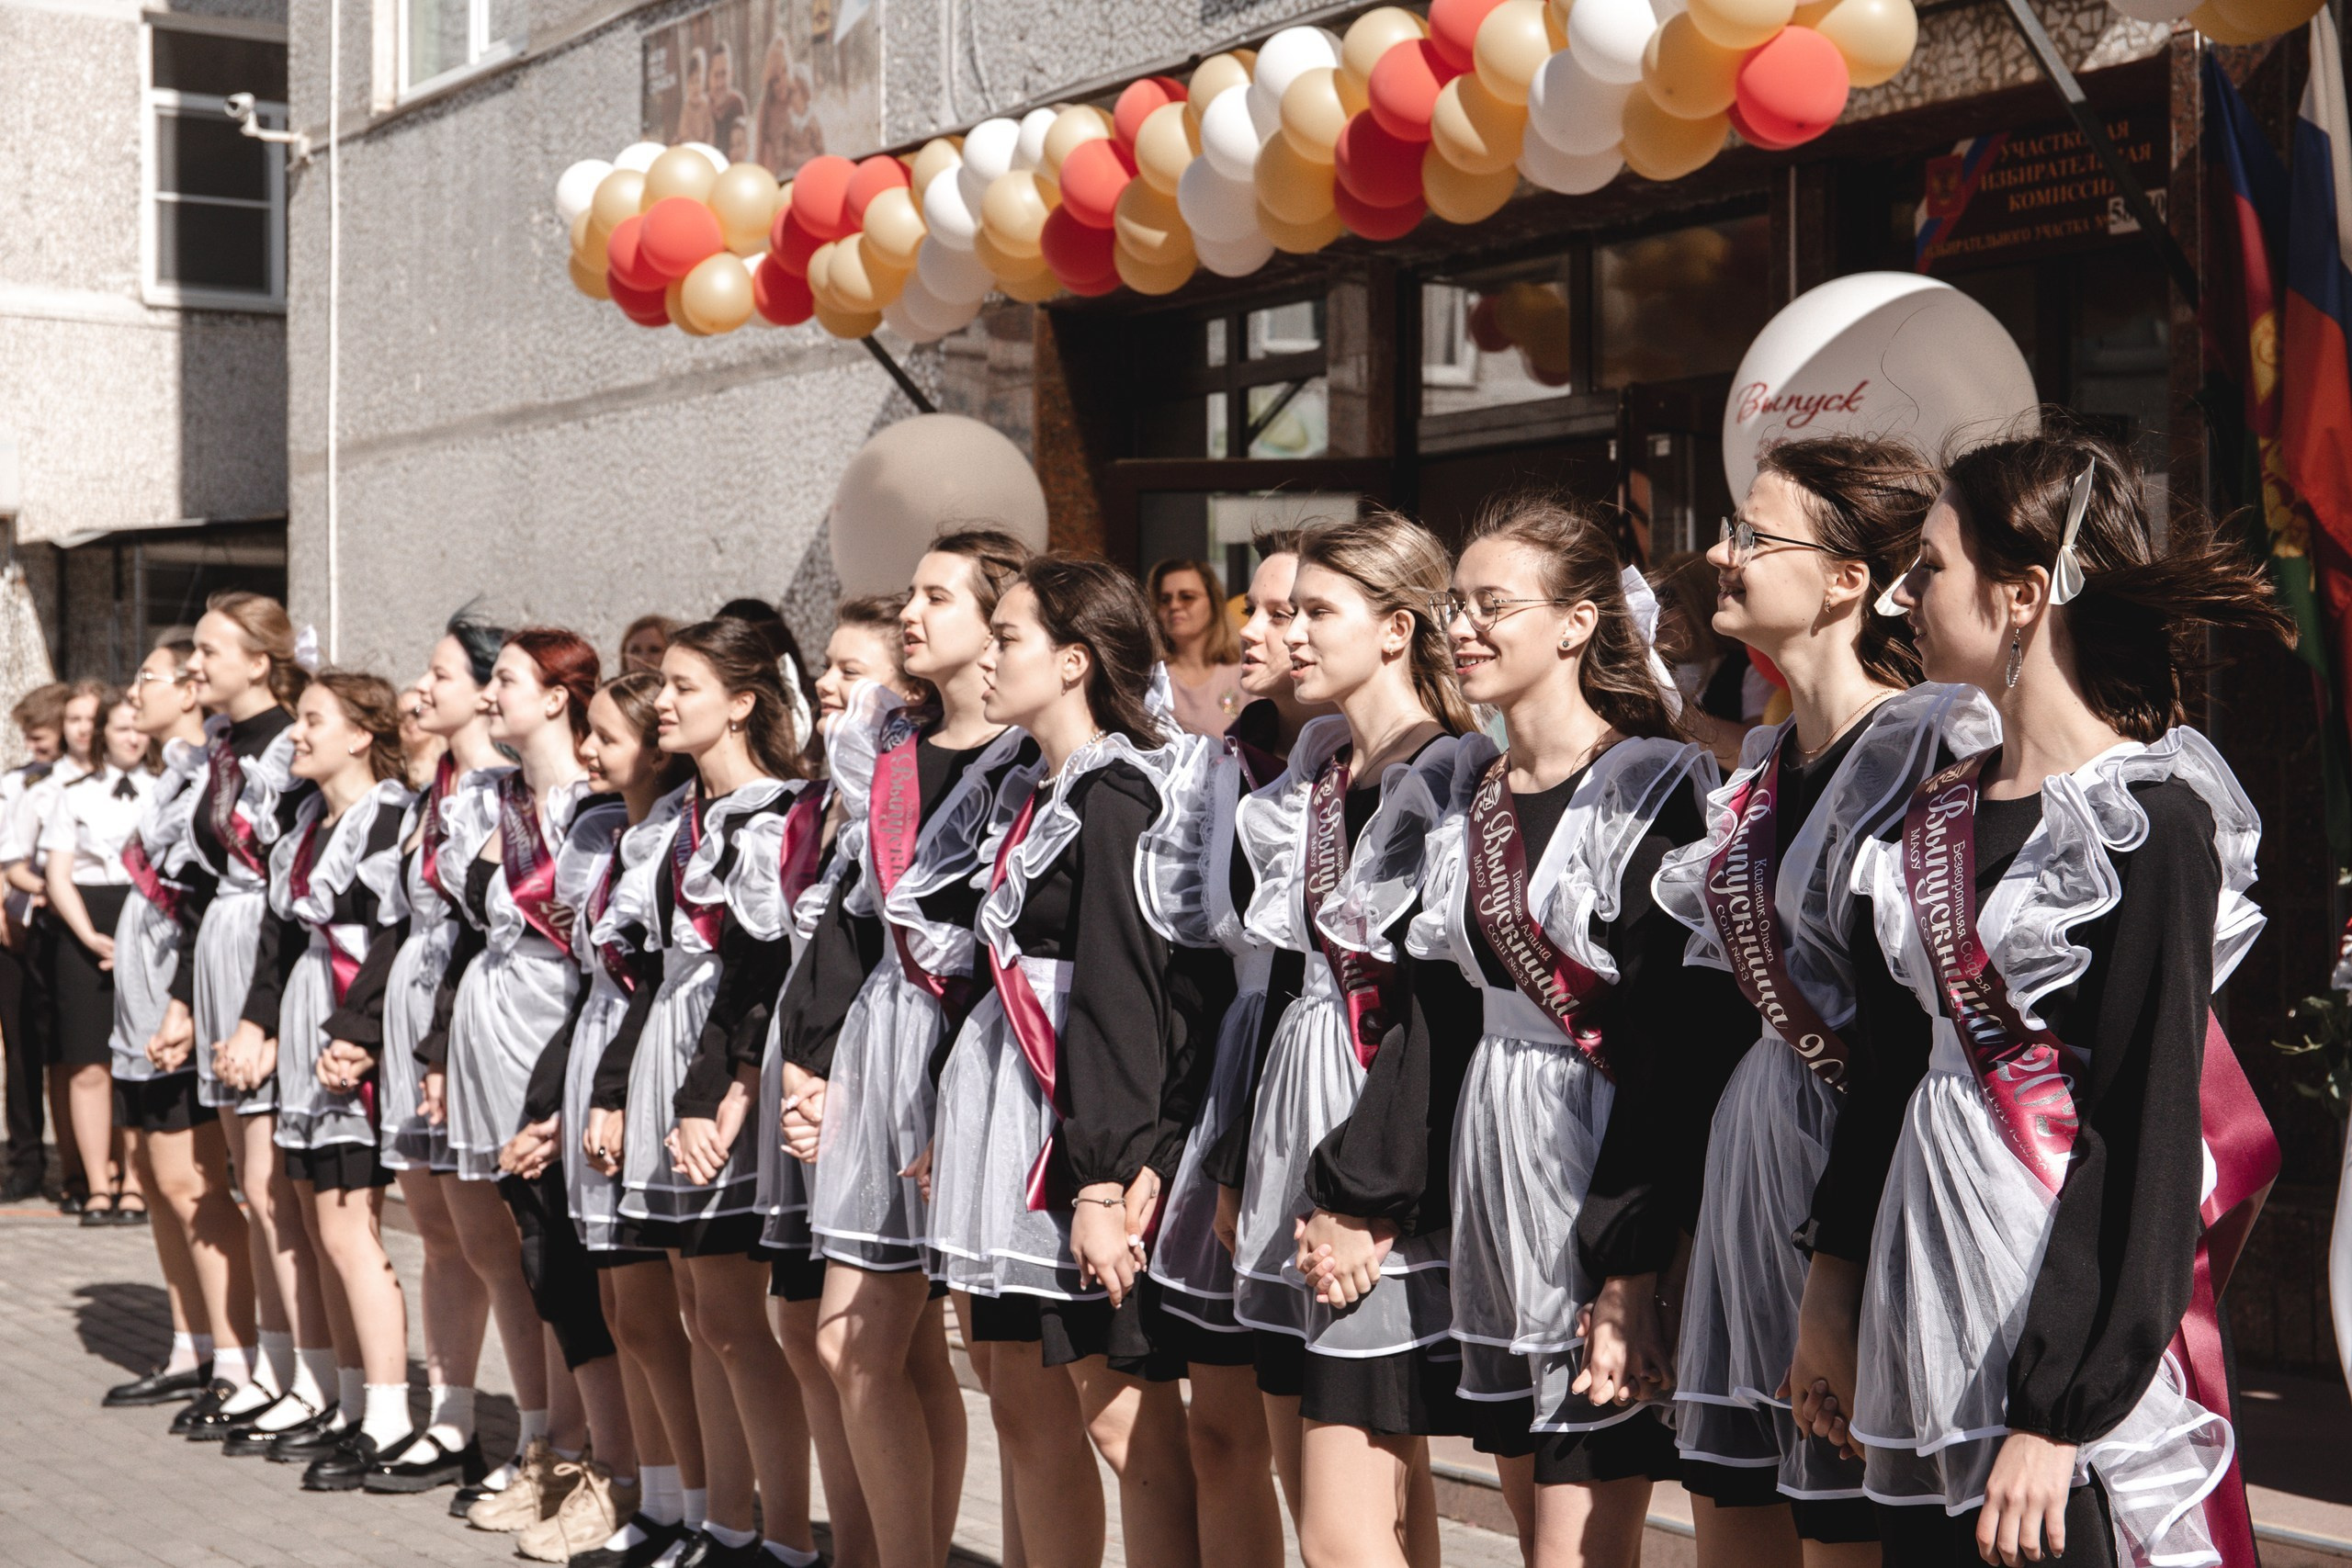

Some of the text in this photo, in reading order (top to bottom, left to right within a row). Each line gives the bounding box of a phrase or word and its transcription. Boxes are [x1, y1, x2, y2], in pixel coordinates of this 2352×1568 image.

[2000, 120, 2129, 162] УЧАСТКОАЯ
[1736, 379, 1870, 428] Выпуск
[1473, 853, 1487, 889] МАОУ
[1910, 827, 1922, 871] МАОУ
[1480, 810, 1579, 1019] Выпускница
[1512, 869, 1553, 961] Петрова Алина
[1710, 788, 1789, 1030] Выпускница
[1716, 905, 1750, 982] СОШ №33
[1755, 858, 1774, 964] Каленик Ольга
[1914, 784, 2008, 1044] Выпускница
[1951, 840, 1992, 995] Безворотняя Софья
[1487, 923, 1529, 987] СОШ №33
